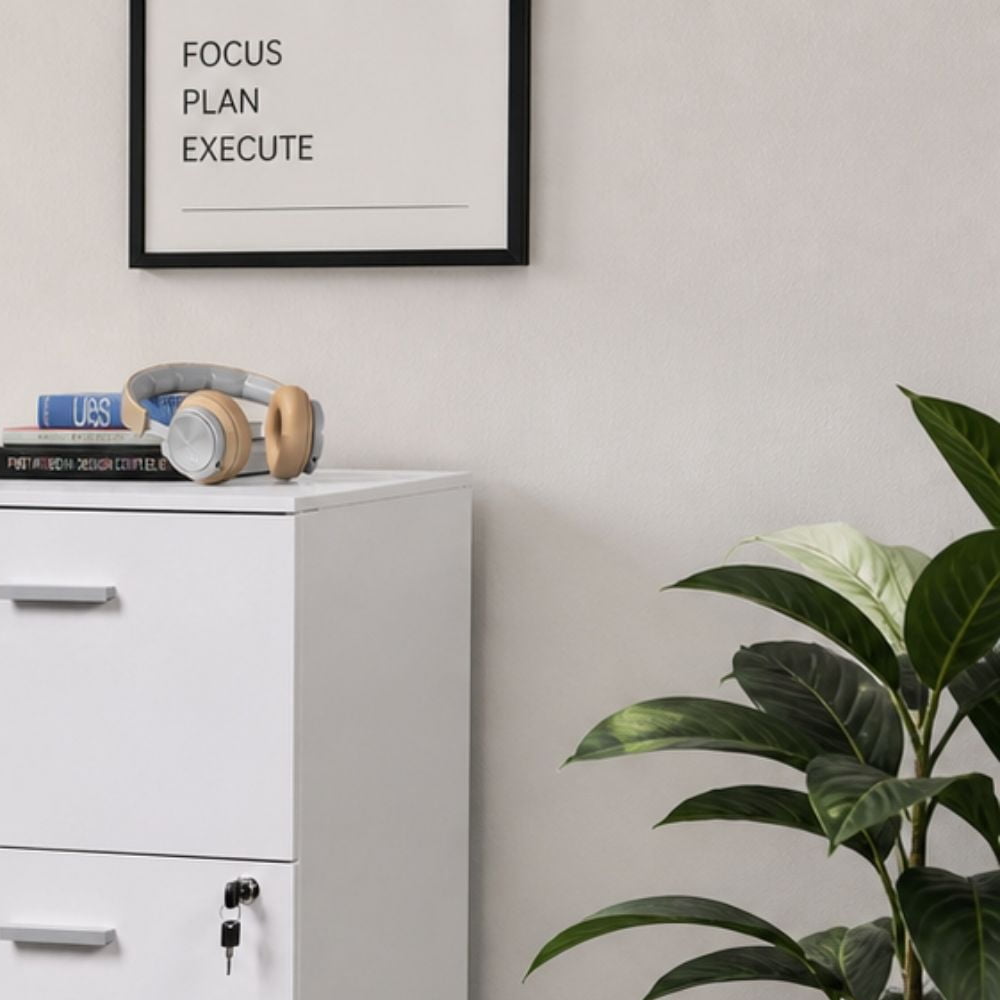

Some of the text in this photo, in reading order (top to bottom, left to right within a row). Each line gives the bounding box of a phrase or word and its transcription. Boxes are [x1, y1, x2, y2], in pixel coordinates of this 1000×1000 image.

[183, 38, 283, 67] FOCUS
[183, 87, 259, 115] PLAN
[183, 134, 314, 162] EXECUTE
